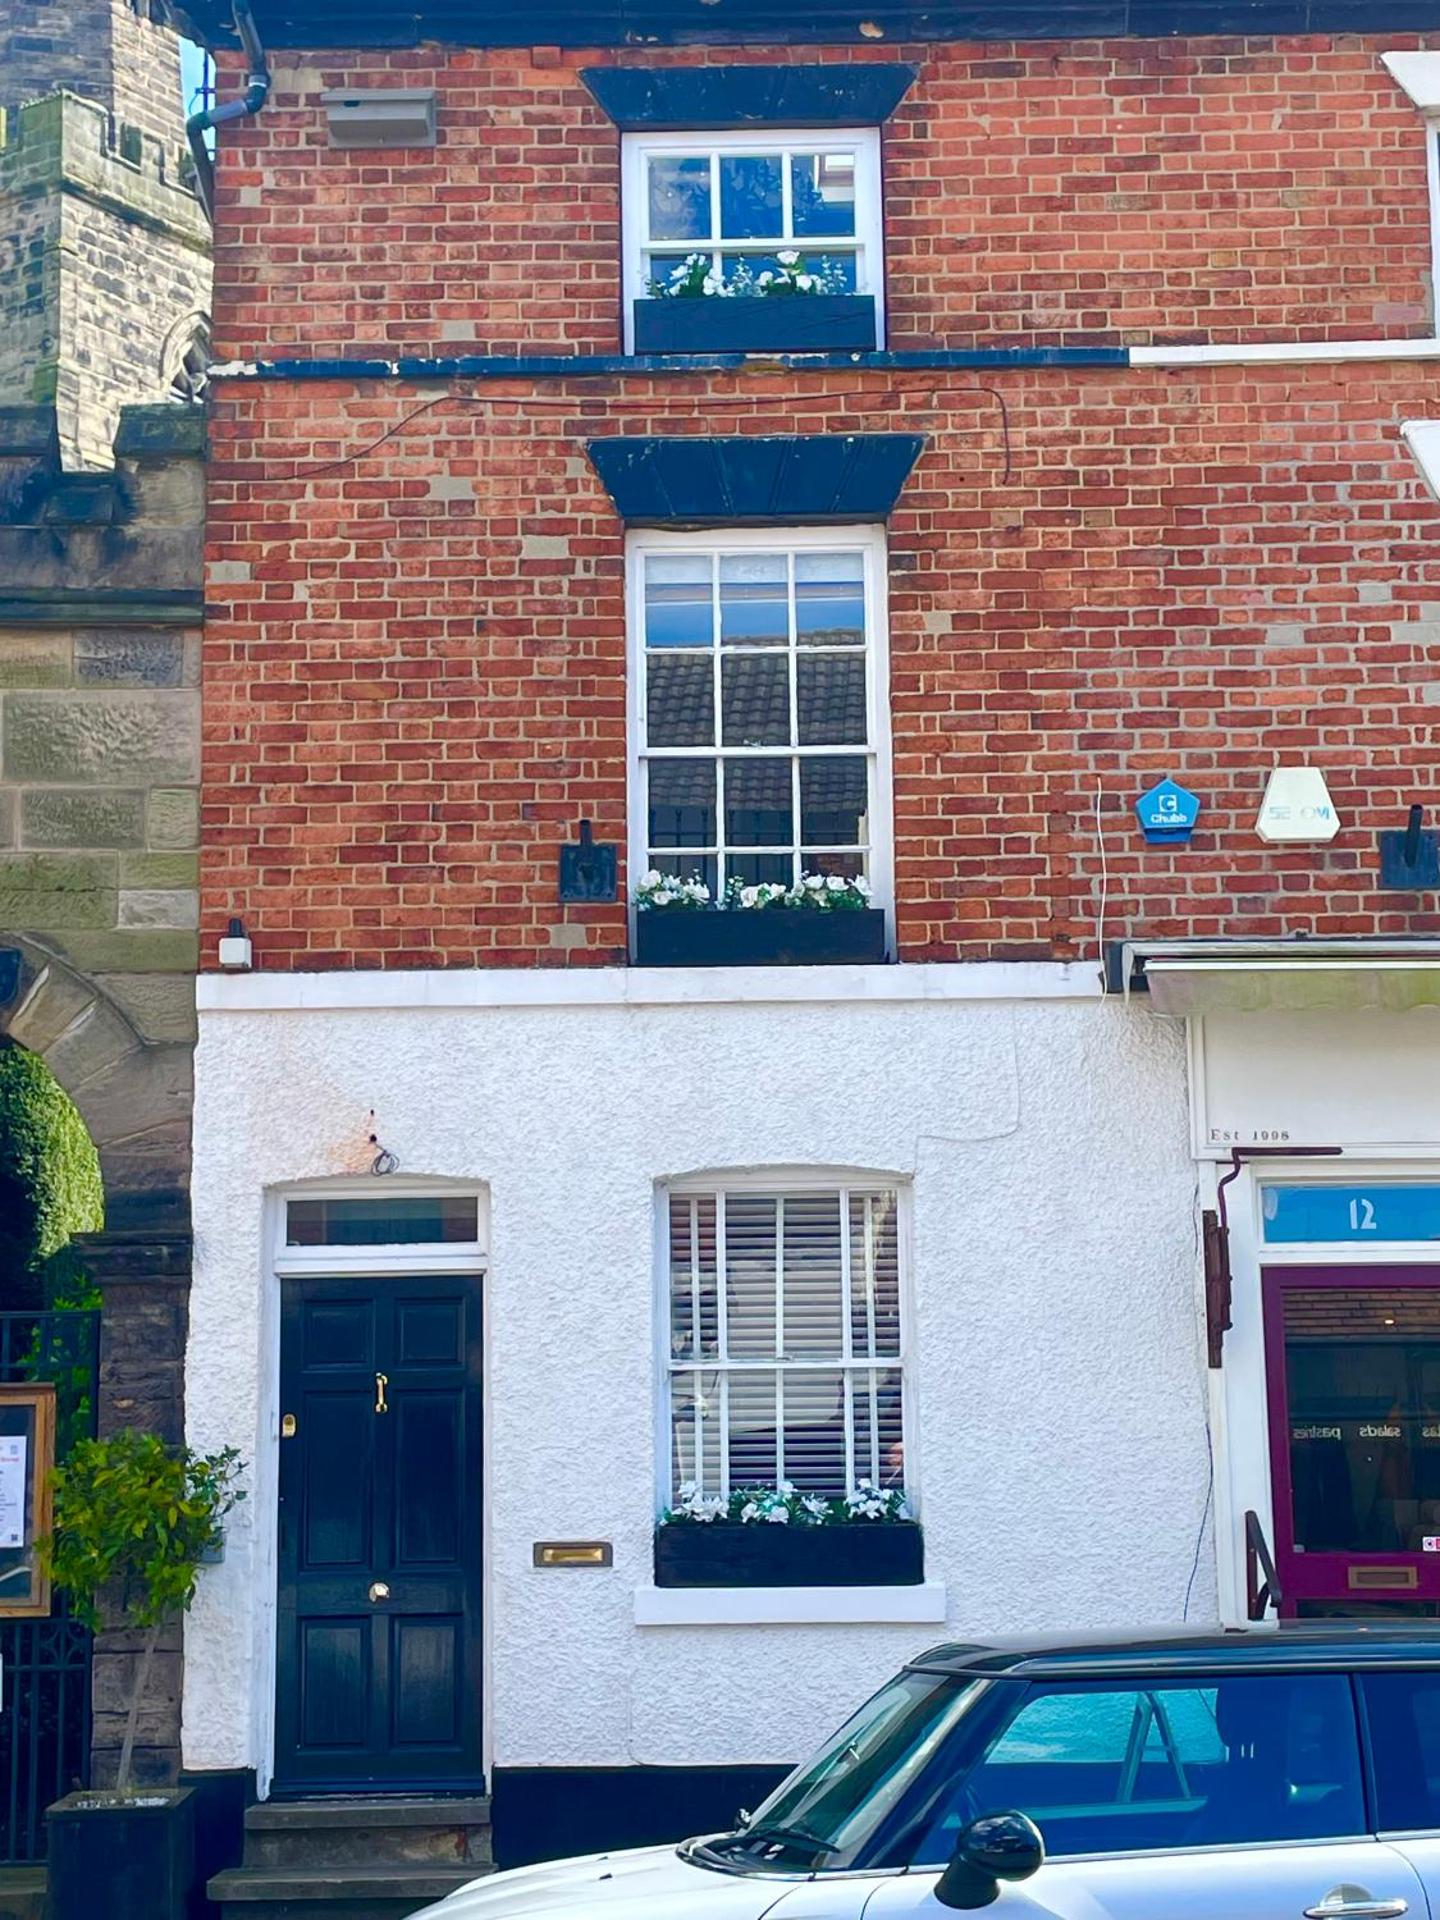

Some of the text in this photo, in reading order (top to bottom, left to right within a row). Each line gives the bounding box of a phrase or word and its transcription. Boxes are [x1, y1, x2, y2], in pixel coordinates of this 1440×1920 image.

[1150, 813, 1188, 823] Chubb
[1269, 806, 1331, 820] SEOM
[1211, 1129, 1290, 1141] Est 1998
[1350, 1199, 1377, 1230] 12
